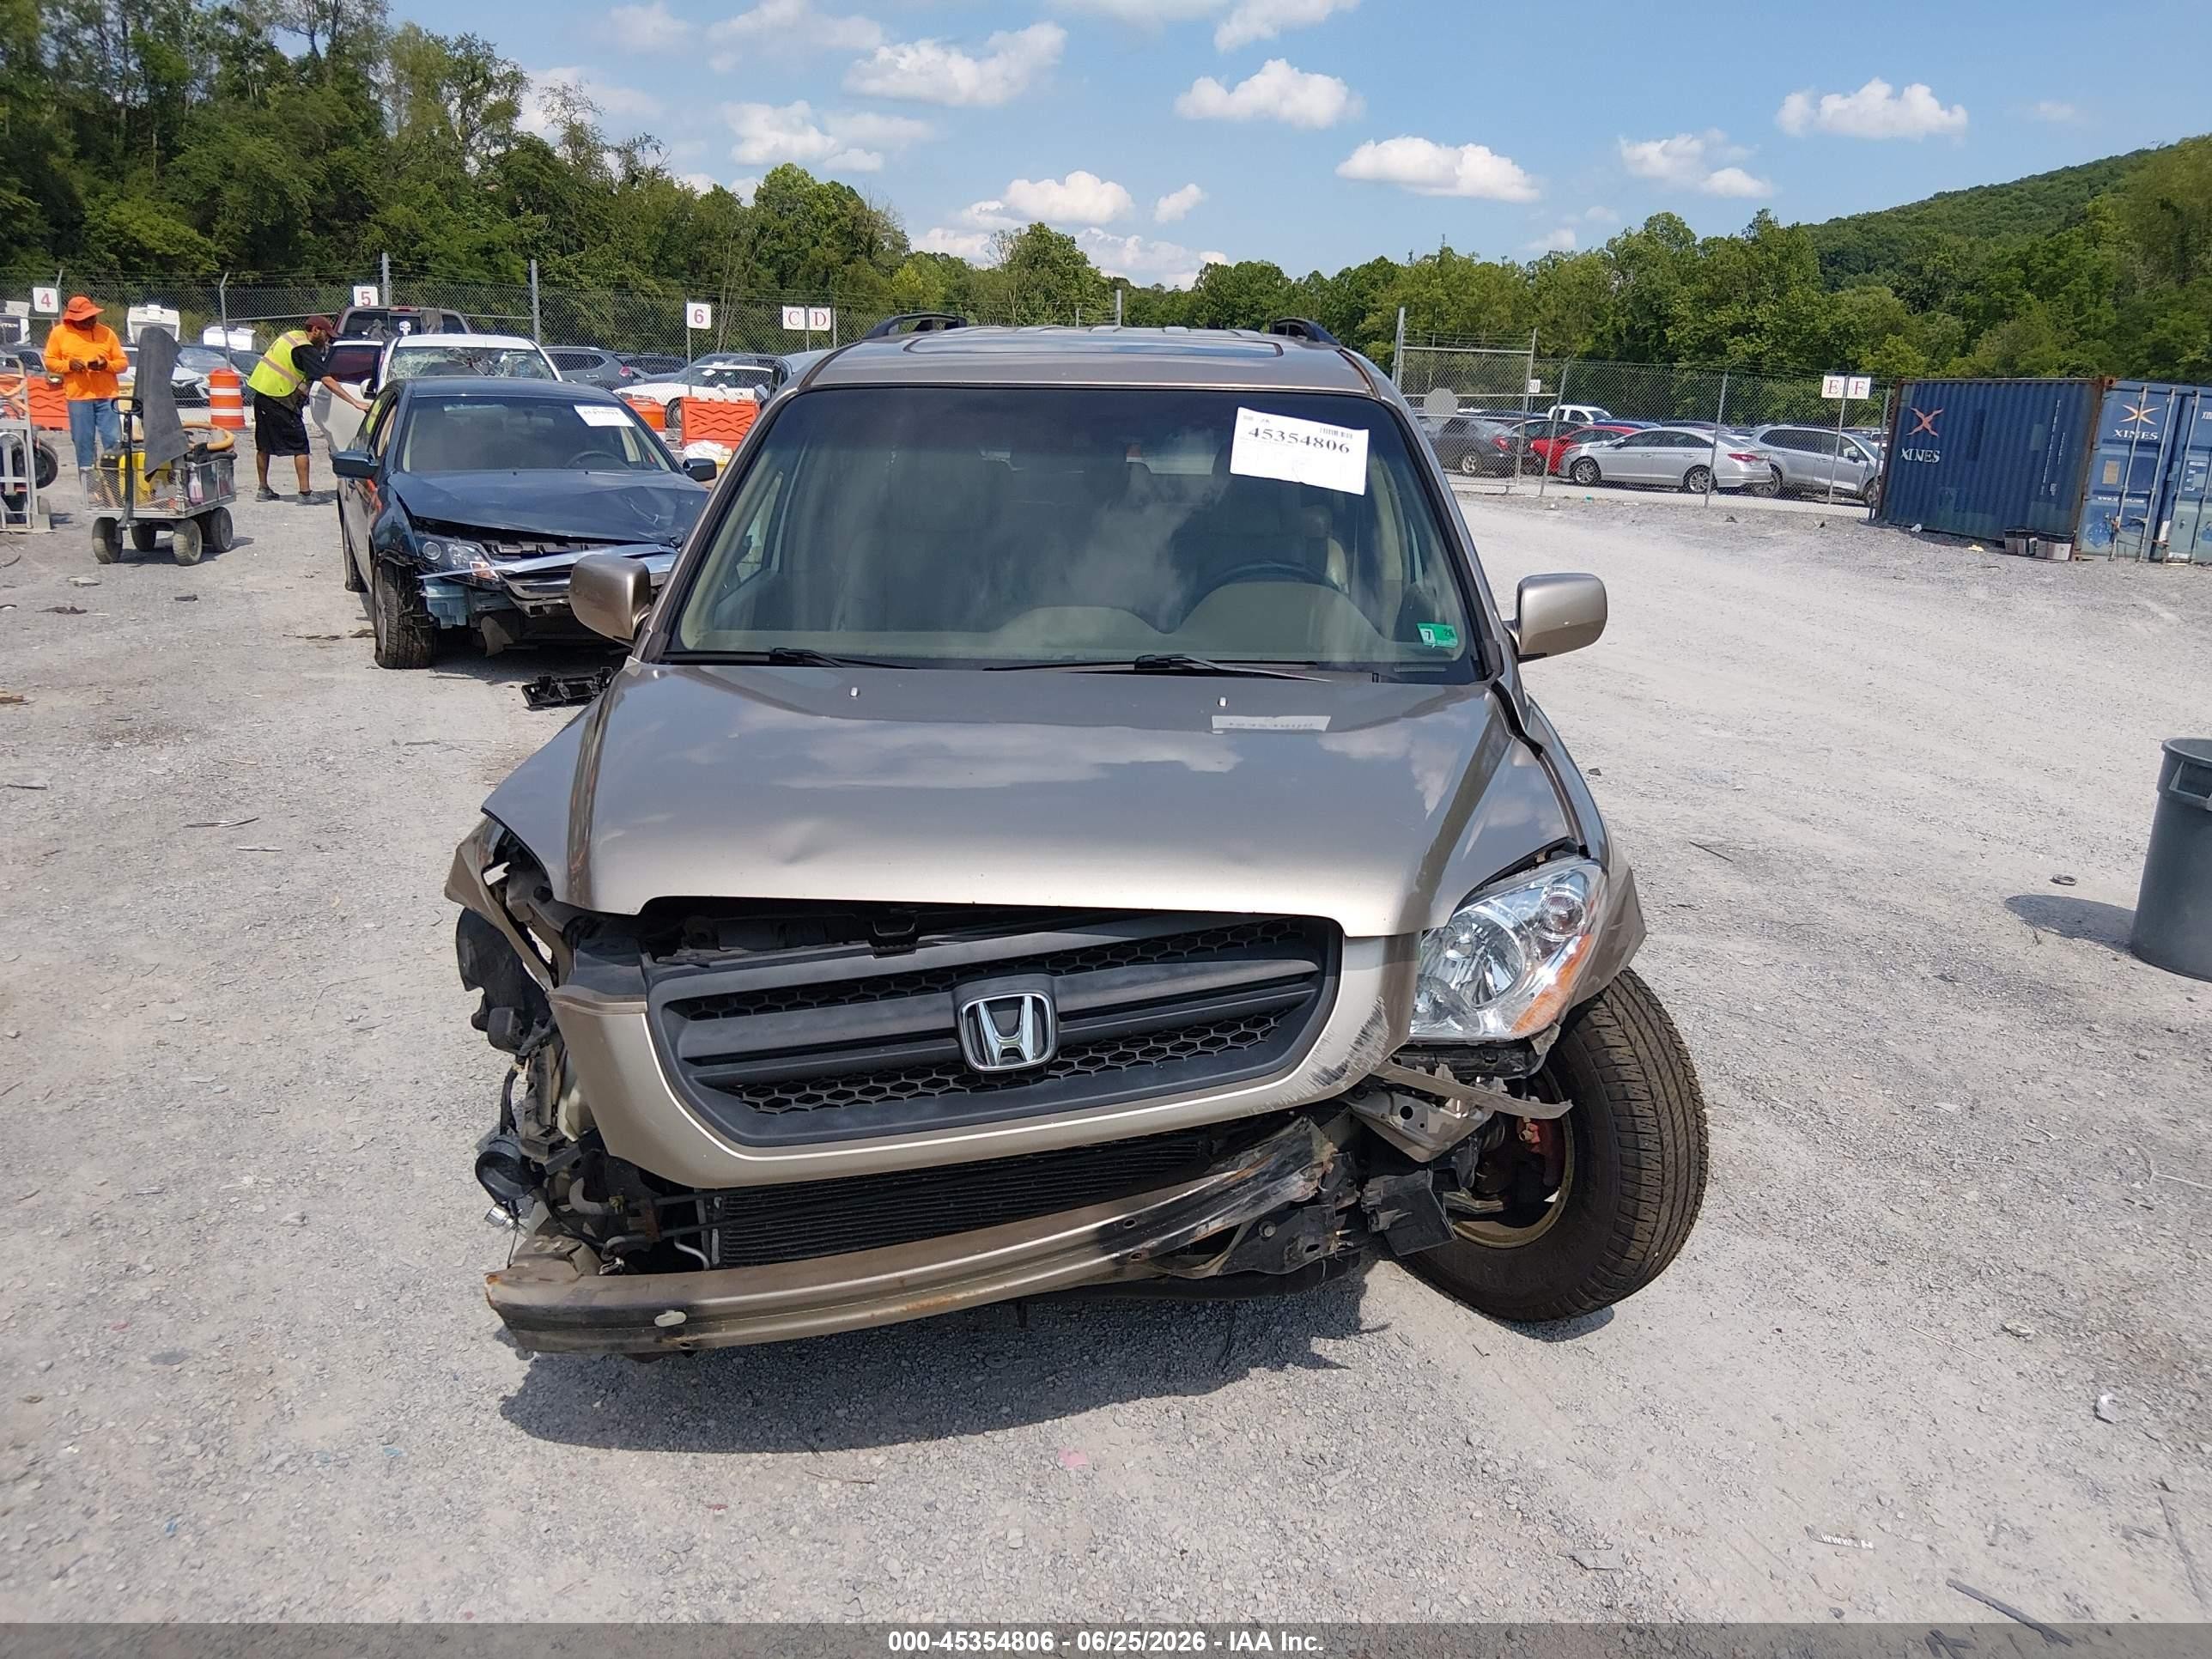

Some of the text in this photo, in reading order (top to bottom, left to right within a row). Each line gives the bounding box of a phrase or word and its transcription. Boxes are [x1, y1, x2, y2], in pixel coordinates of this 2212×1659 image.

[41, 293, 52, 307] 4
[361, 291, 372, 307] 5
[693, 308, 705, 325] 6
[788, 311, 800, 326] C
[814, 311, 827, 326] D
[1826, 380, 1839, 394] E
[1854, 380, 1865, 395] F
[1248, 427, 1351, 454] 45354806
[1899, 447, 1942, 464] XINES
